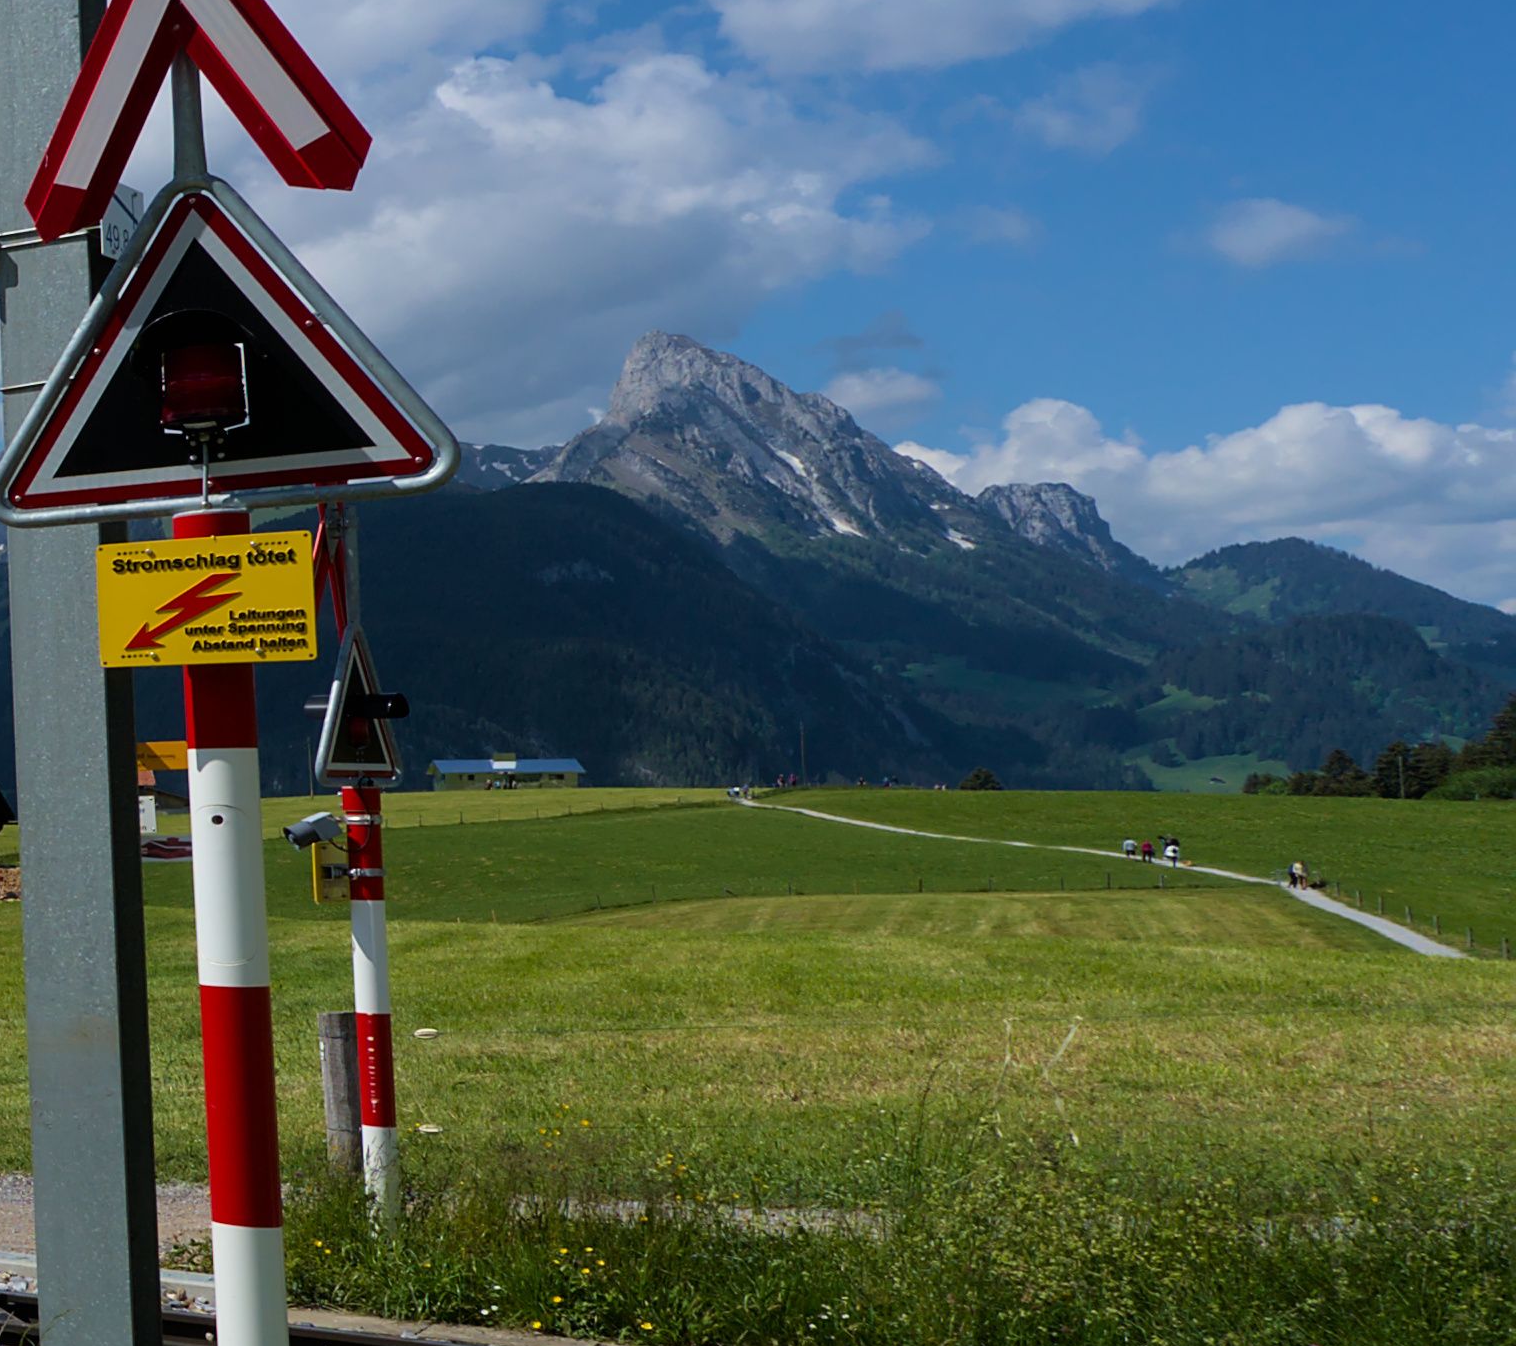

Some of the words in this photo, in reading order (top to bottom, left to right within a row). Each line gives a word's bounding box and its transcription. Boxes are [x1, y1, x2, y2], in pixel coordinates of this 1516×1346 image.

[112, 552, 240, 574] Stromschlag
[246, 548, 297, 566] tötet
[229, 608, 307, 622] Leitungen
[184, 624, 225, 637] unter
[228, 620, 306, 635] Spannung
[192, 636, 254, 651] Abstand
[259, 636, 307, 650] halten
